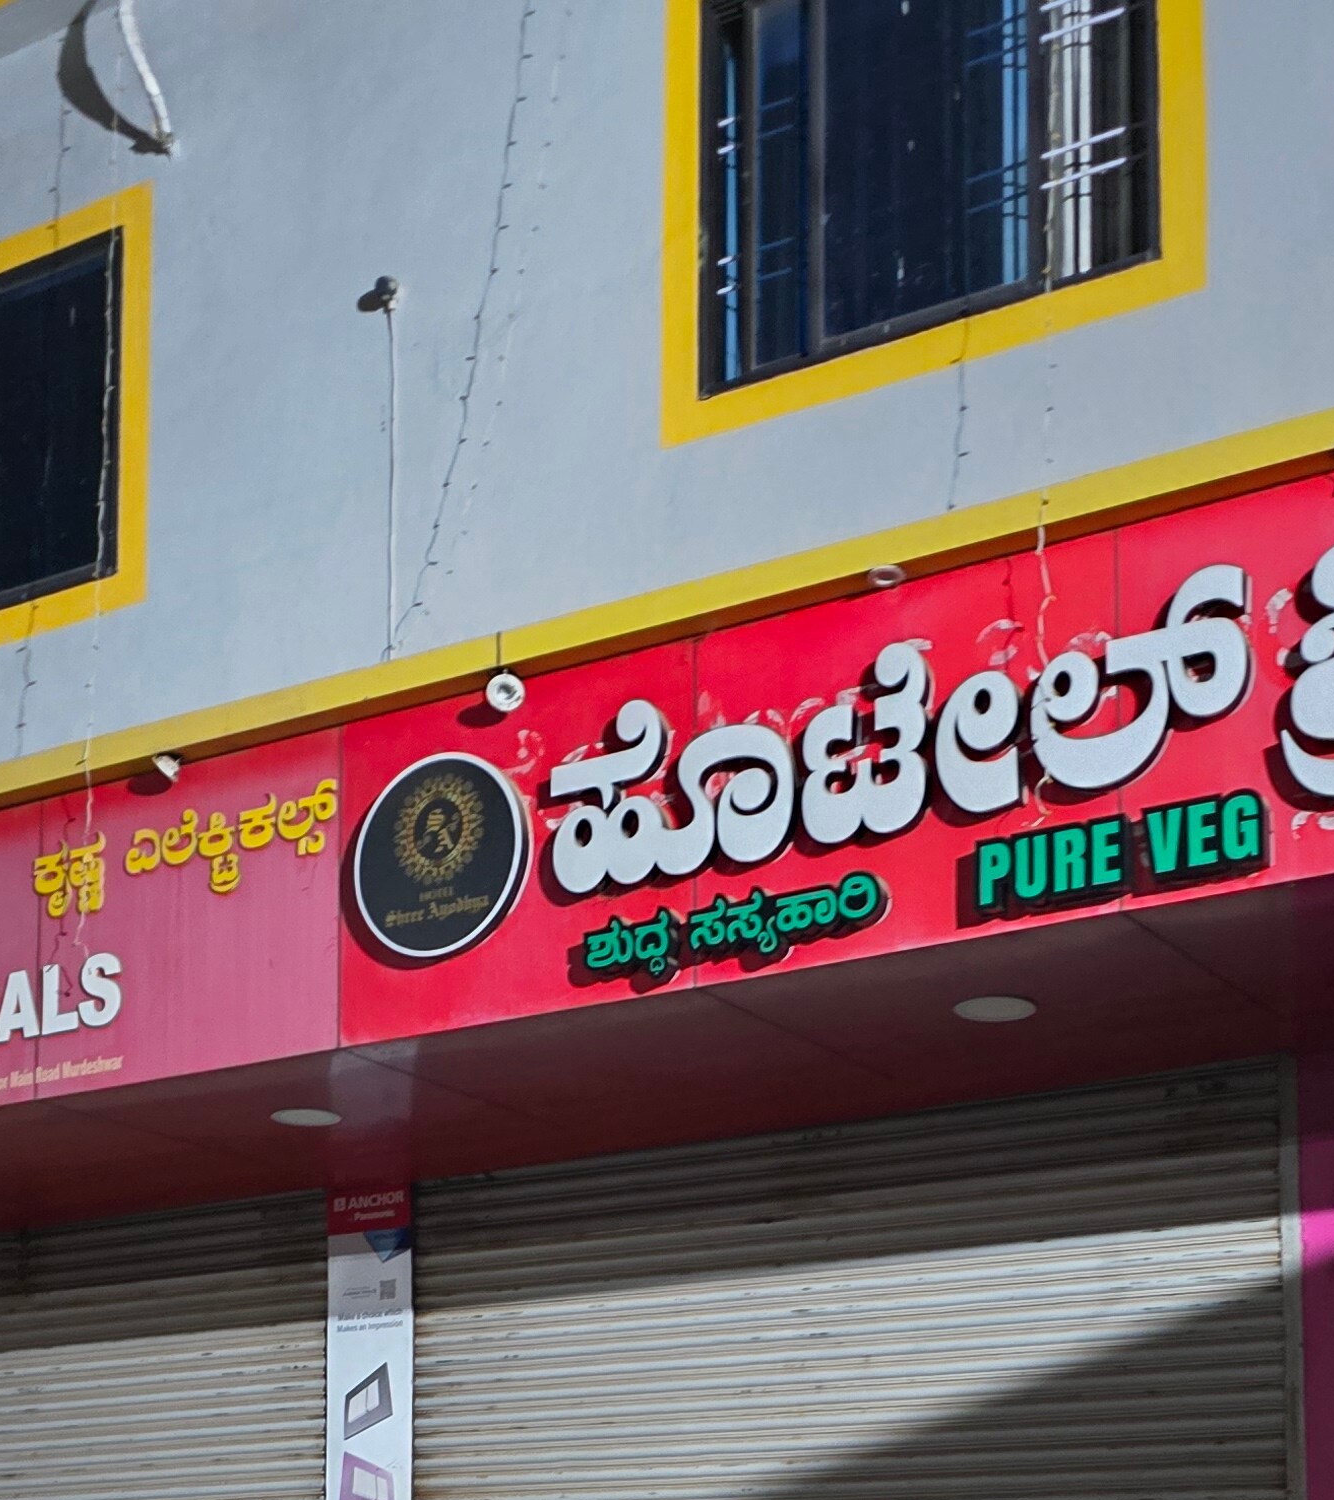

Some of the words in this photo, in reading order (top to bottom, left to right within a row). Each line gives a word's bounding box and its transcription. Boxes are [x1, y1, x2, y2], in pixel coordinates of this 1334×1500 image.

[33, 831, 107, 918] ಕೃಷ್ಣ
[978, 820, 1123, 907] PURE
[1145, 793, 1259, 874] VEG
[583, 910, 669, 976] ಶುದ್ಧ
[348, 1191, 405, 1209] ANCHOR
